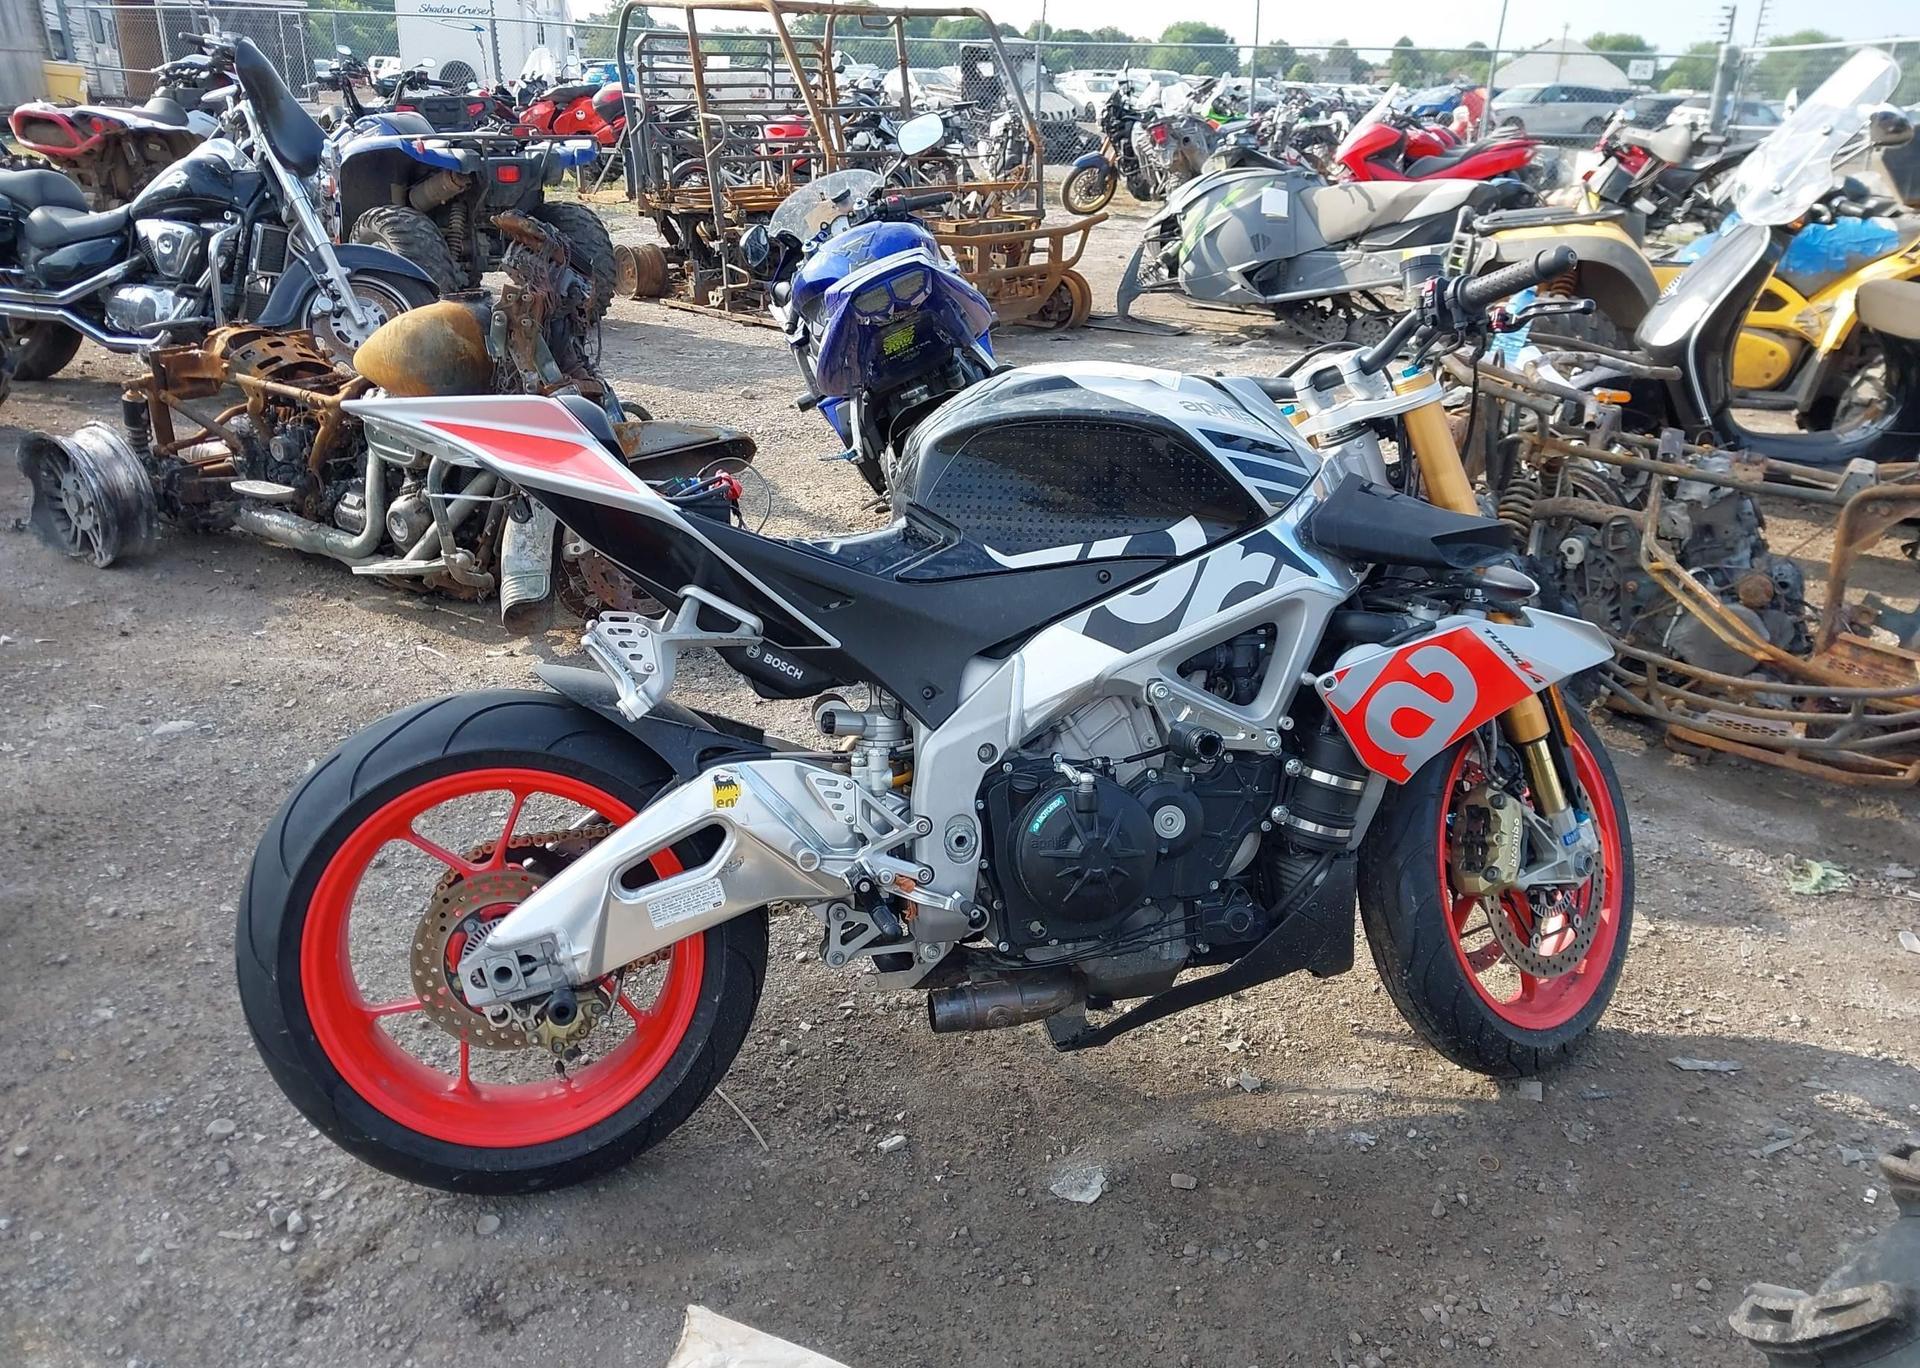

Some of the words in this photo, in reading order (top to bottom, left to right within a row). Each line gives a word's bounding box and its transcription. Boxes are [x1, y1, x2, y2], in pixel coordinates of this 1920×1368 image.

[418, 4, 456, 14] Shadow
[457, 5, 492, 15] Cruiser
[763, 652, 804, 680] BOSCH
[1036, 797, 1063, 824] MOTOREX
[1508, 817, 1520, 868] brembo
